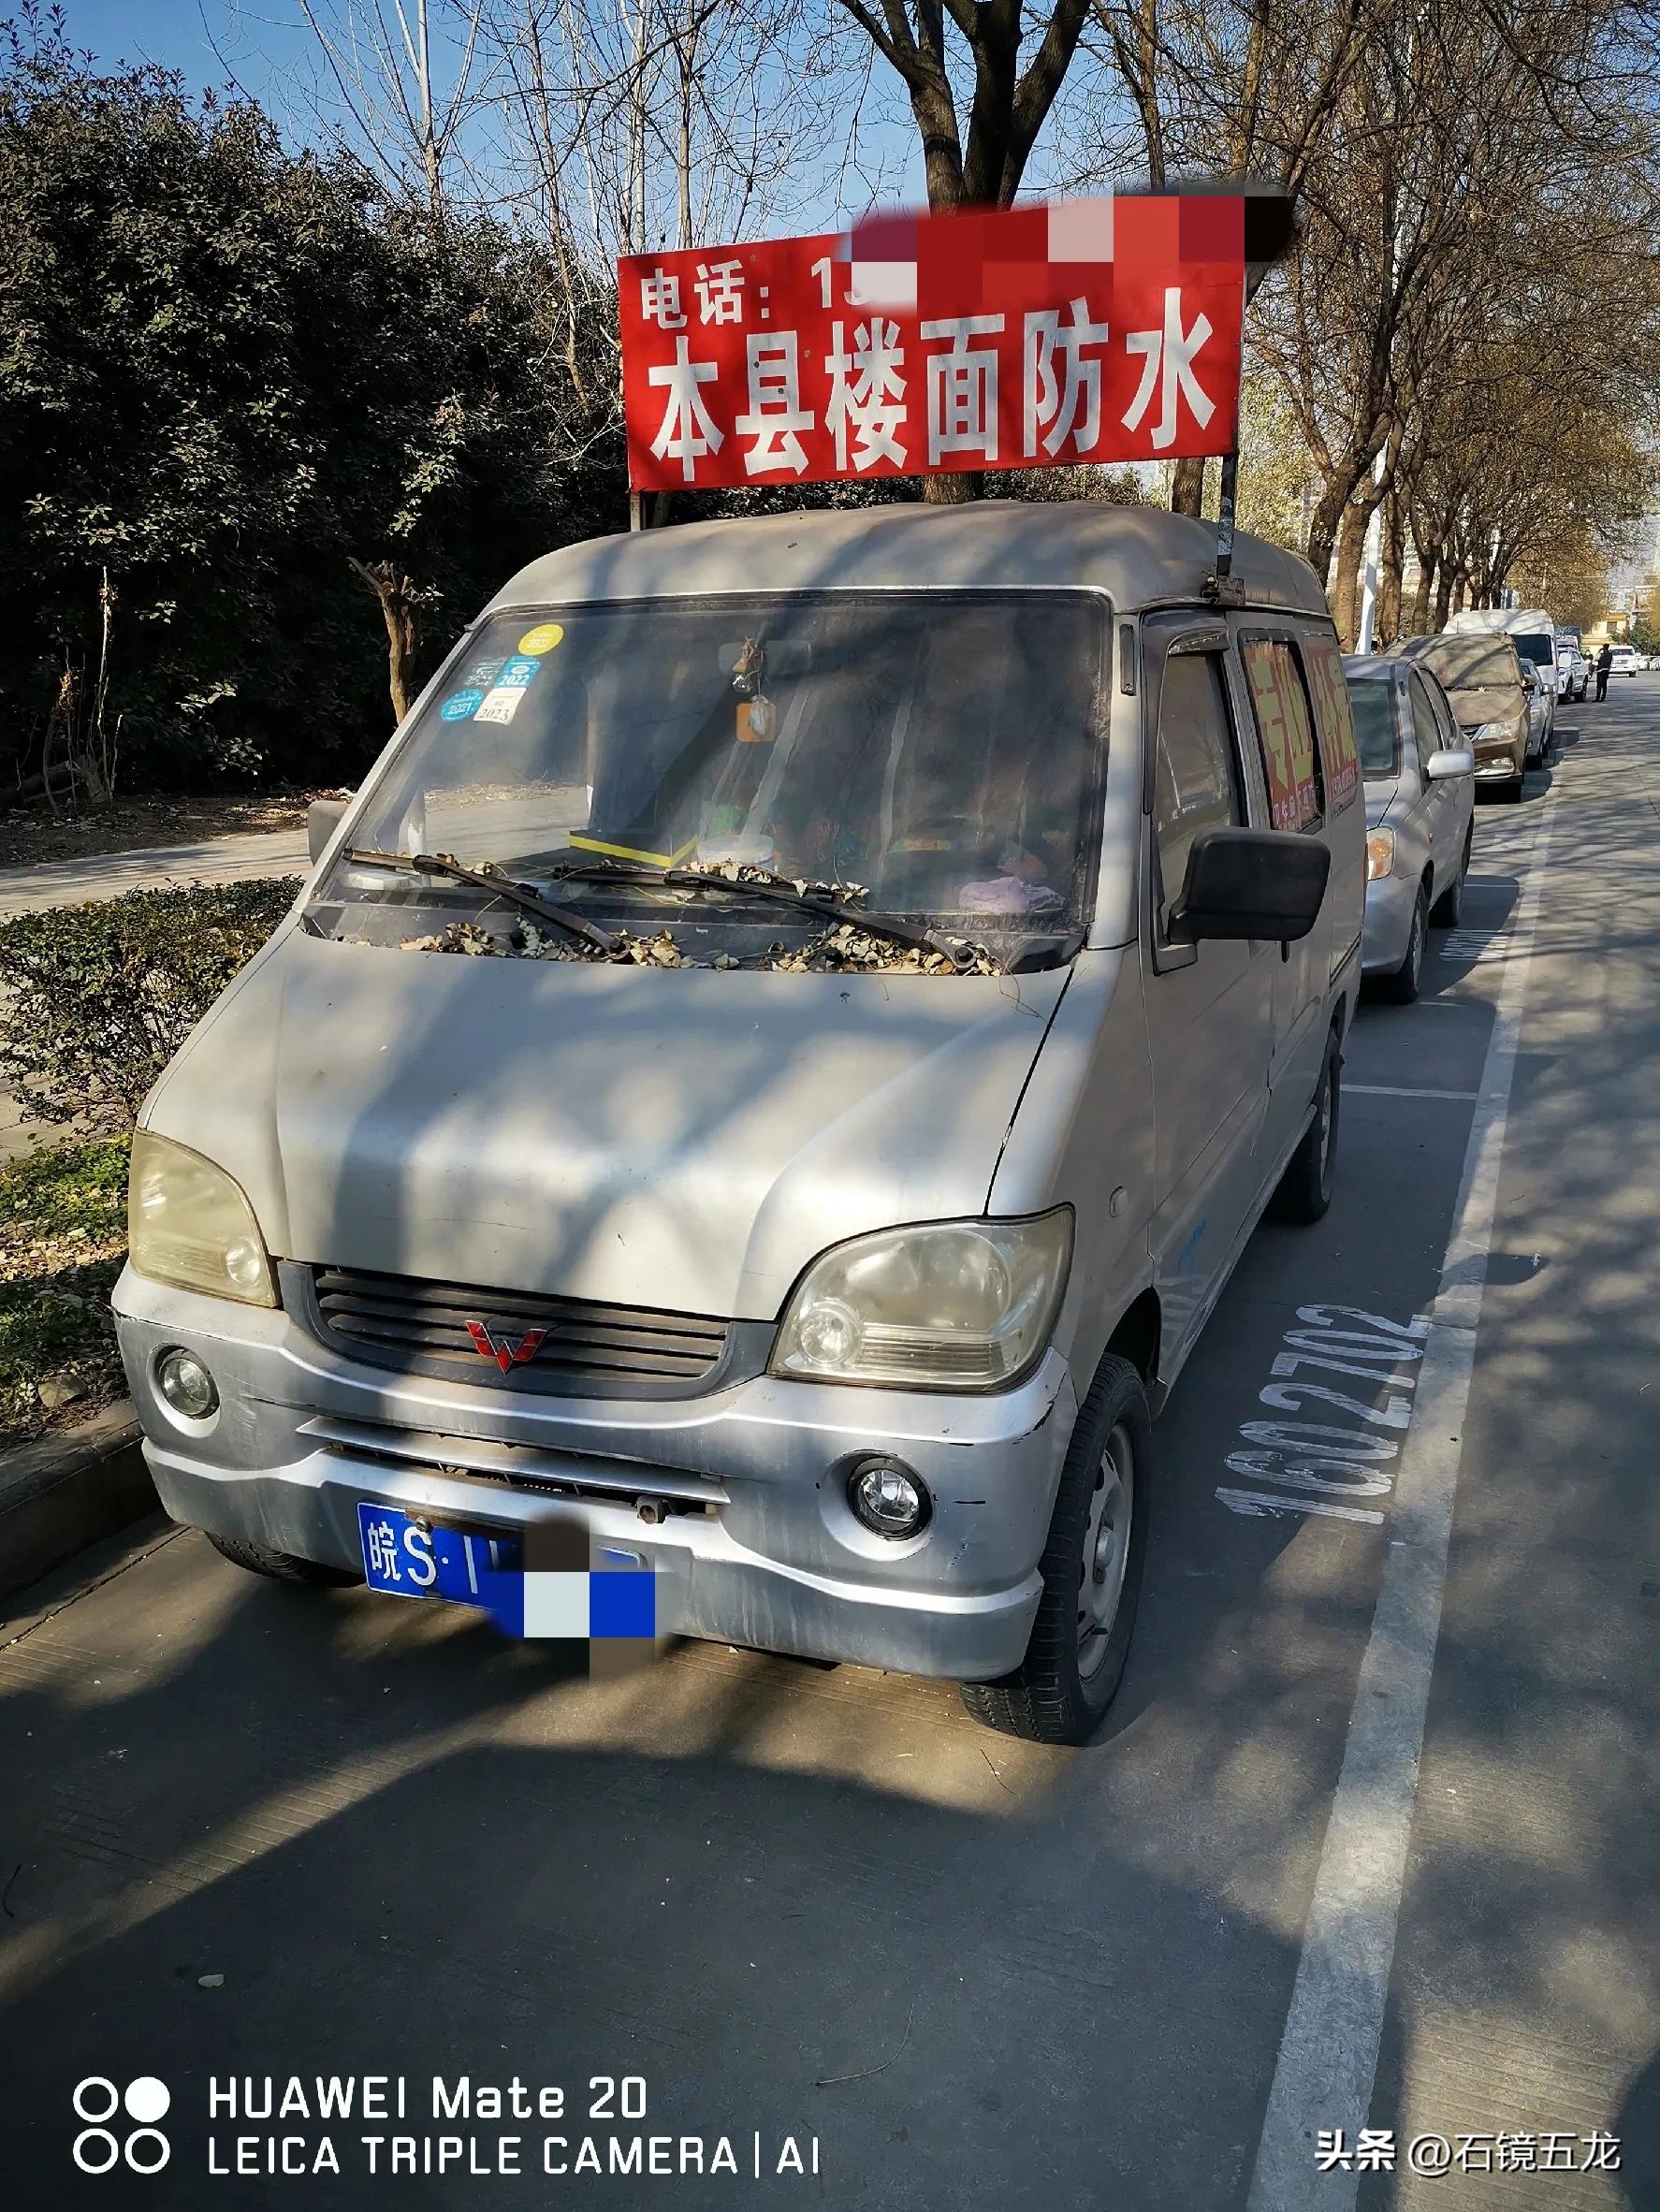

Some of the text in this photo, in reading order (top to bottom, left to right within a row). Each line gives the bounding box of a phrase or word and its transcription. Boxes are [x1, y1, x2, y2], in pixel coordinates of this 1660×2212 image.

[648, 286, 1217, 483] 本县楼面防水
[477, 708, 510, 721] 2023
[498, 675, 530, 686] 2022
[1214, 1303, 1433, 1525] 1602702
